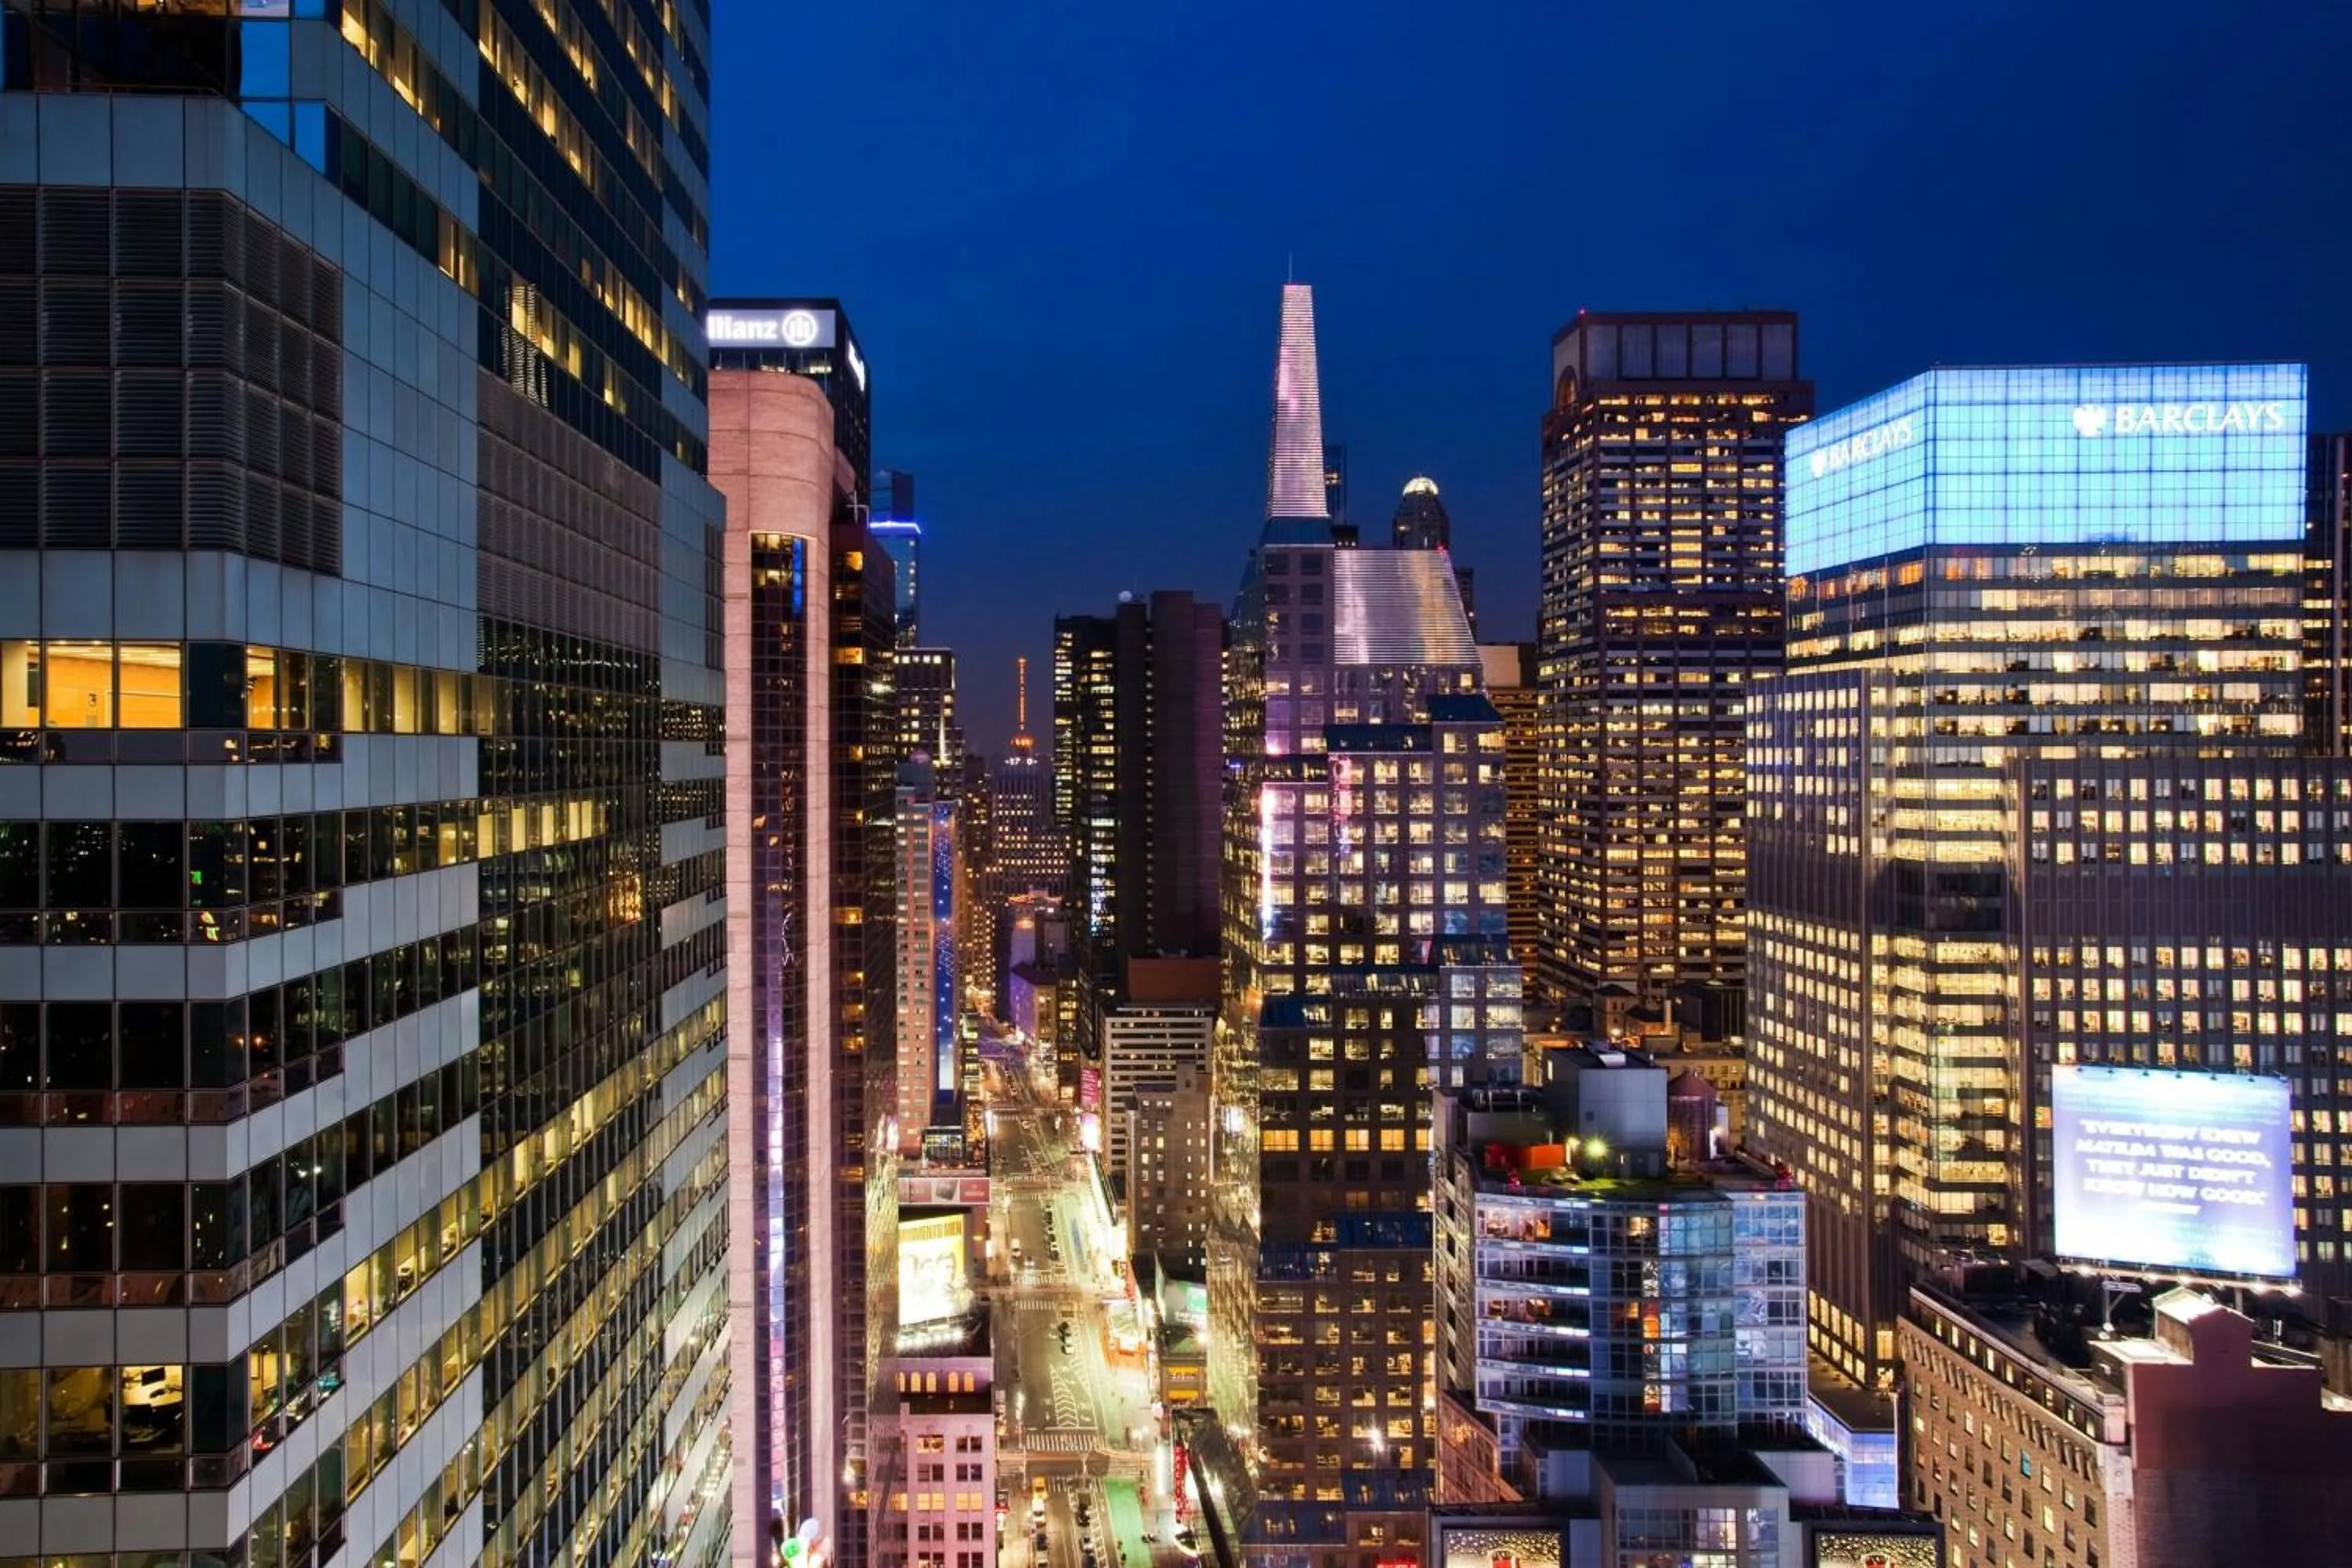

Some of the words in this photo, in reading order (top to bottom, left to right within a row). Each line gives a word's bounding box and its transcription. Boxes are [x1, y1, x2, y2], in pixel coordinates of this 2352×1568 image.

[708, 315, 778, 339] llianz
[2114, 402, 2284, 434] BARCLAYS
[1829, 416, 1913, 470] BARCLAYS
